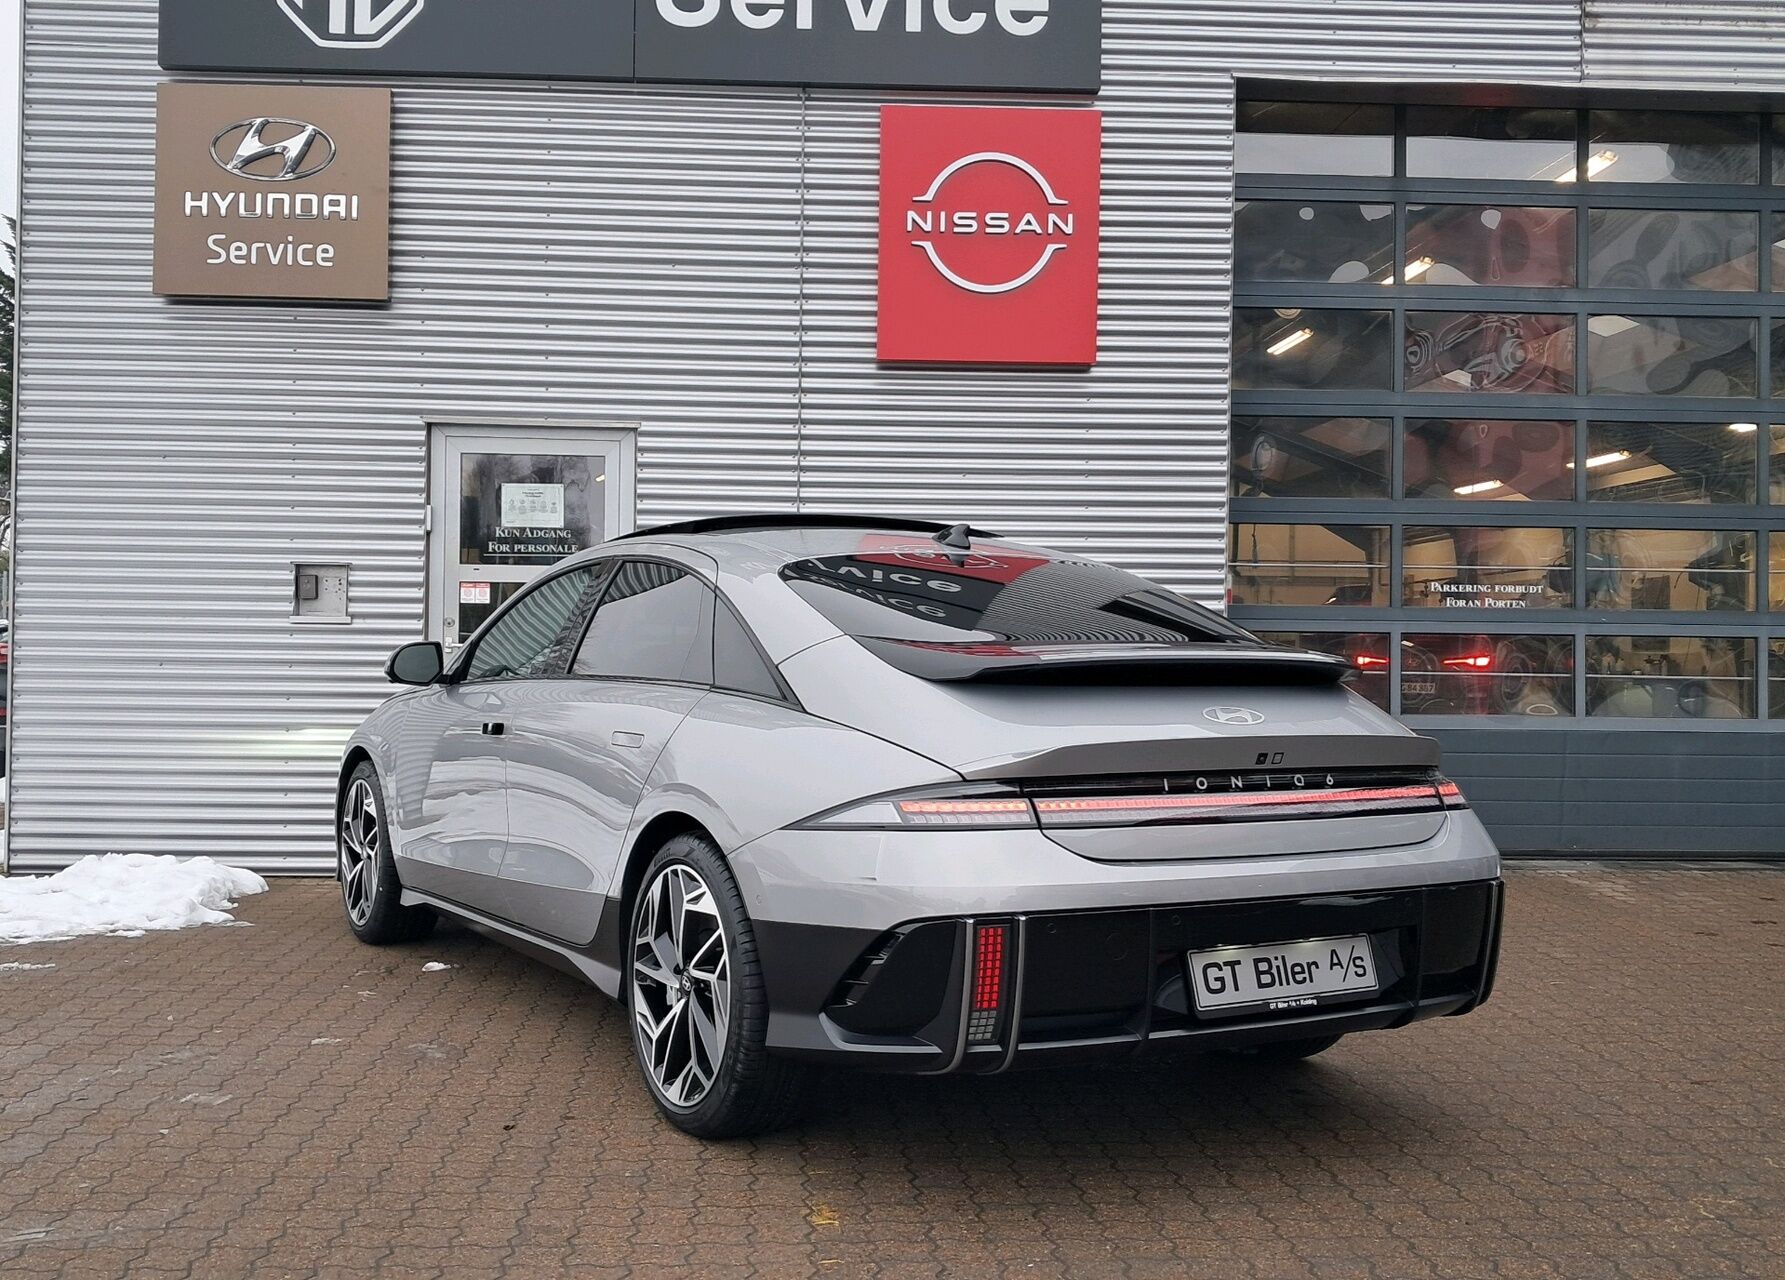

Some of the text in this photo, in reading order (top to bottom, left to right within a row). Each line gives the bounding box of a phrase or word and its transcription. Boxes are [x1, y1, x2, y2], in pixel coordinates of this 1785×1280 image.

[184, 191, 359, 221] HYUNDAI
[906, 210, 1074, 235] NISSAN
[206, 233, 335, 267] Service
[495, 526, 572, 538] KUN ADGANG
[488, 541, 579, 553] FOR PERSONALE
[1430, 581, 1544, 594] PARKERING FORBUDT
[1446, 597, 1526, 609] FORAN PORTEN
[1163, 773, 1334, 792] IONIQ 6
[1202, 959, 1242, 995] GT
[1252, 954, 1319, 989] Biler
